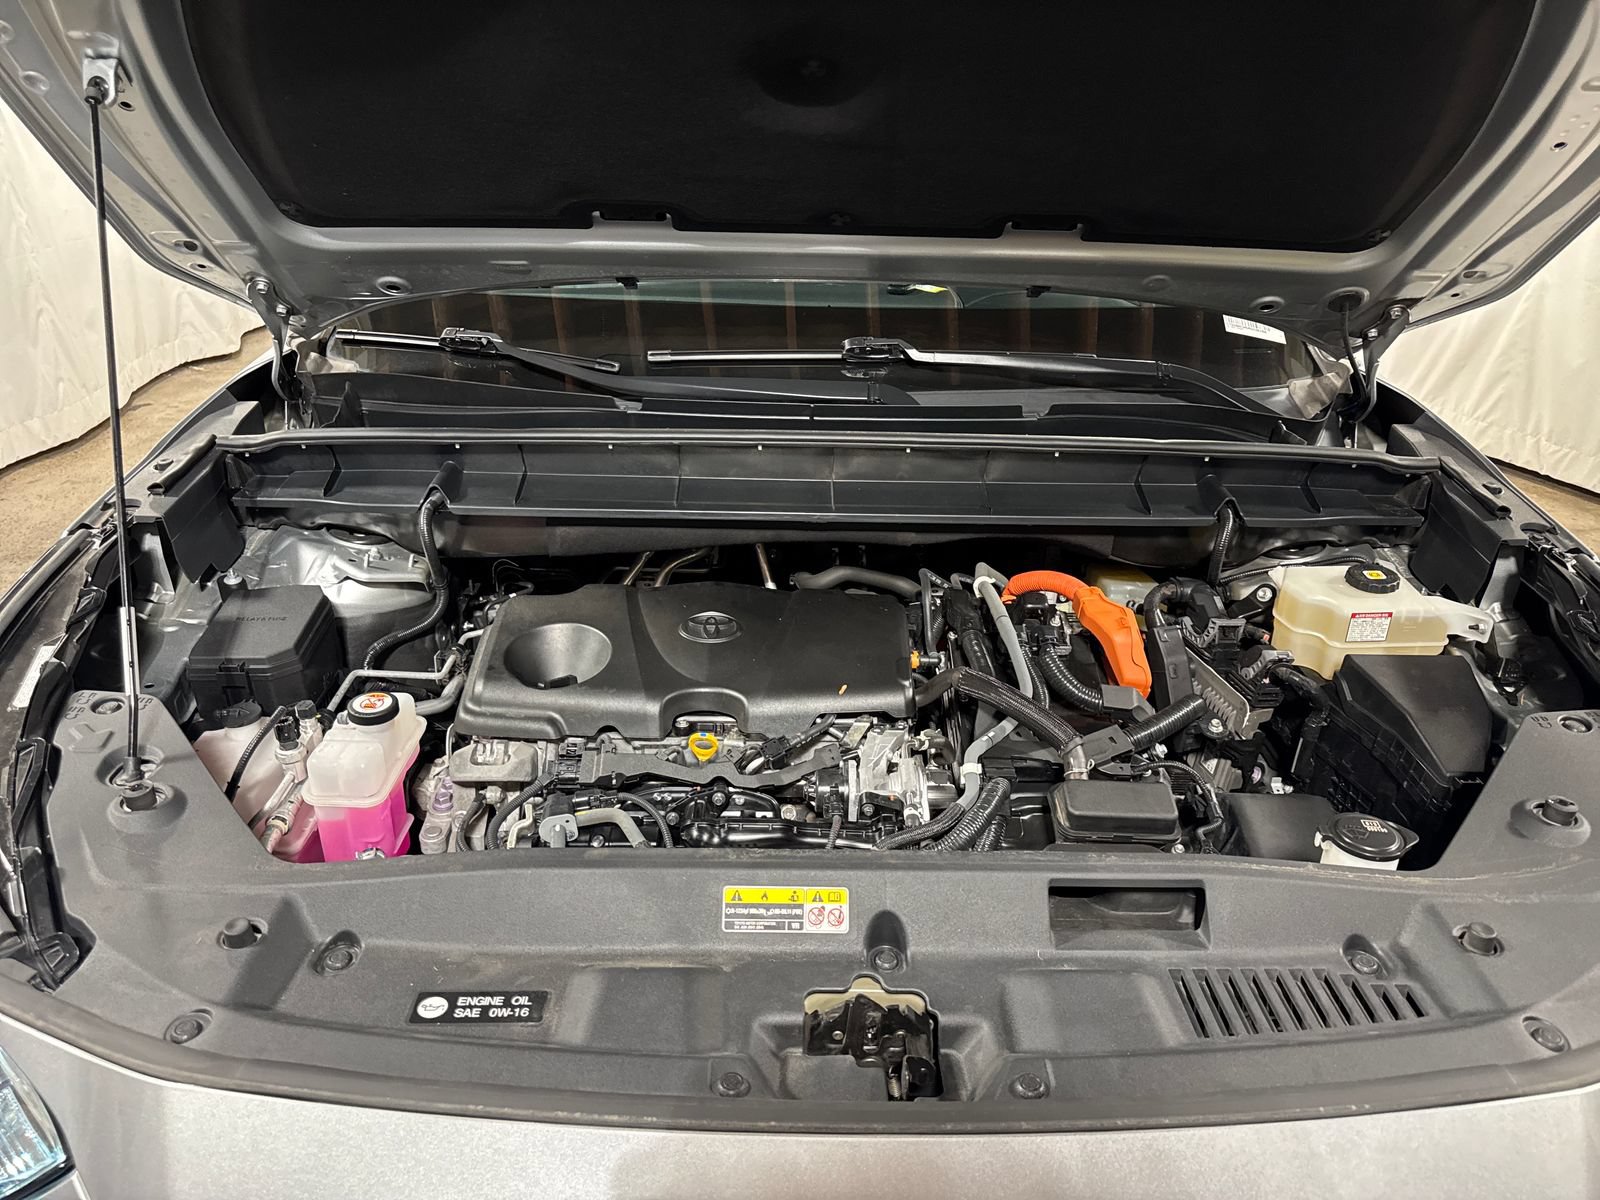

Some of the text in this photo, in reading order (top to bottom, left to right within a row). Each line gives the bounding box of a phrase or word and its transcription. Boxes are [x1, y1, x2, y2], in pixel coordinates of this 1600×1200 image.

[456, 996, 533, 1006] ENGINE OIL
[453, 1007, 530, 1018] SAE 0W-16
